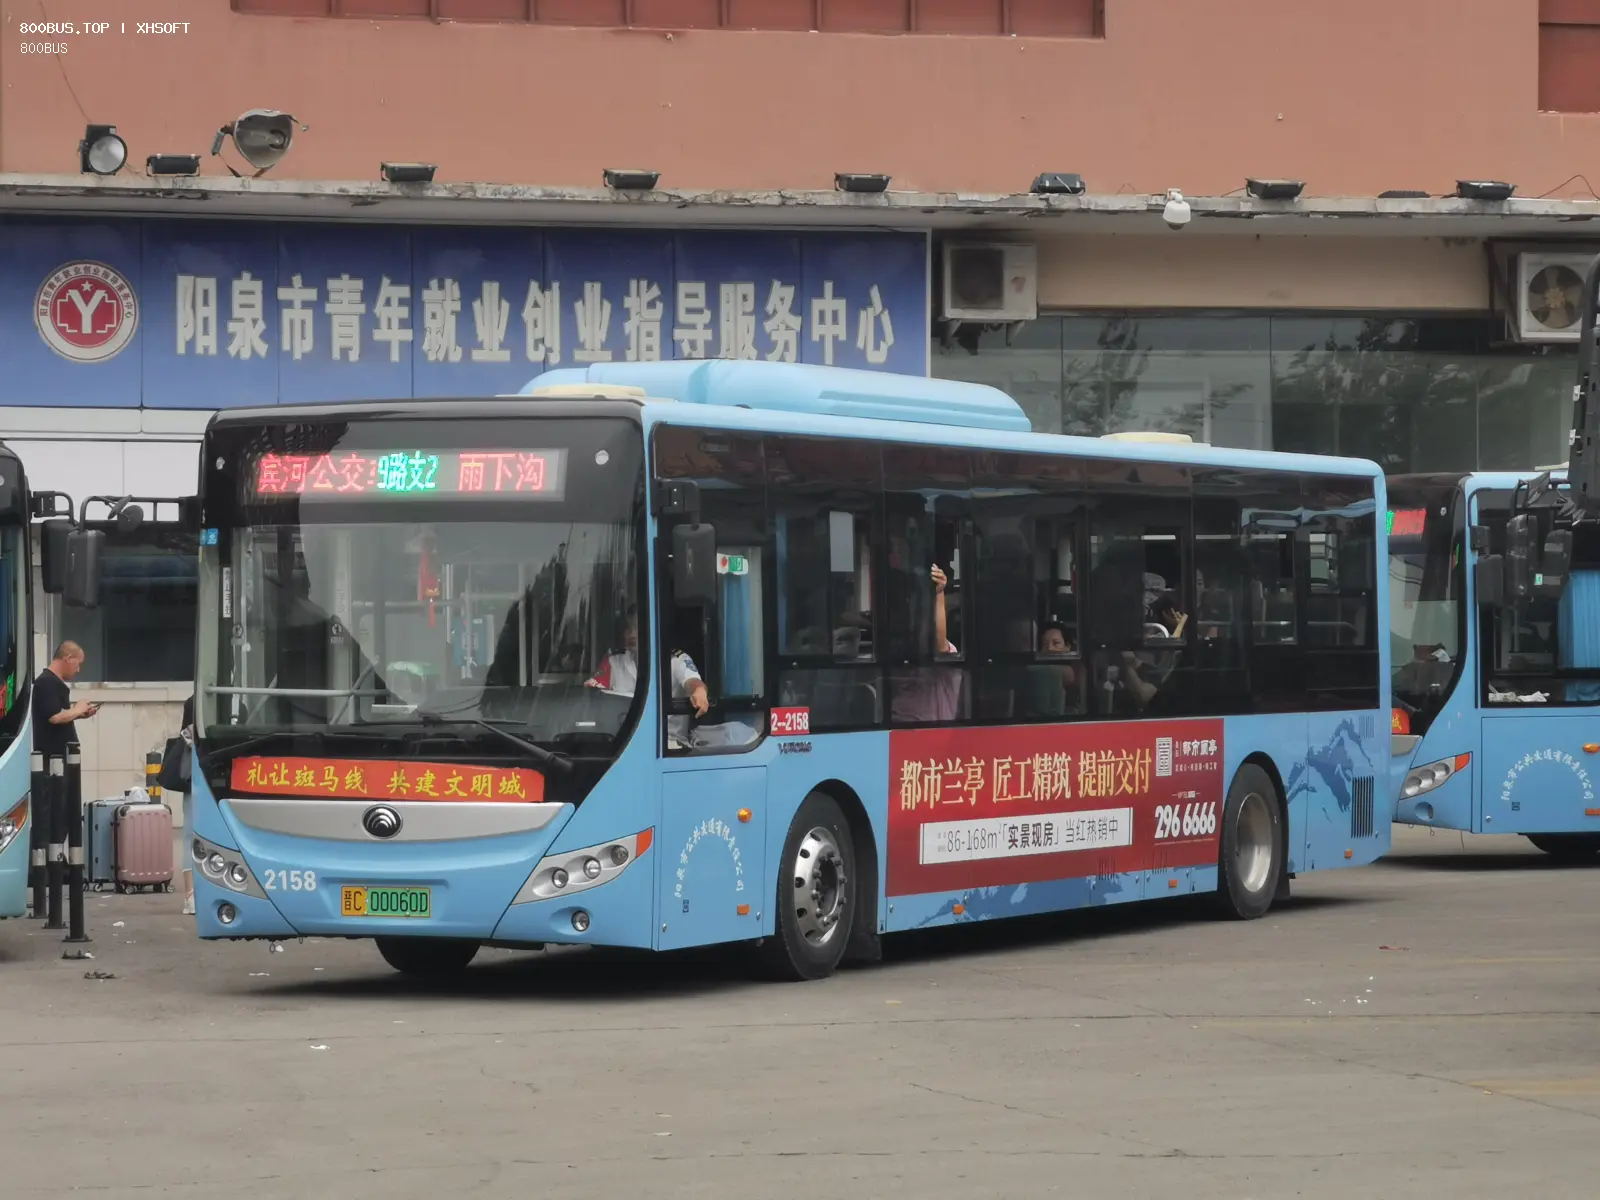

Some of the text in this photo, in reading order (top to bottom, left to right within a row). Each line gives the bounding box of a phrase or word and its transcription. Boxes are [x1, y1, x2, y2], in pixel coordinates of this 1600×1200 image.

[176, 272, 895, 363] 阳泉市青年就业创业指导服务中心
[458, 453, 546, 491] 雨下沟
[248, 761, 526, 799] 礼让斑马线 共建文明城
[899, 749, 1152, 811] 都市兰亭 匠工精筑 提前交付
[1154, 802, 1216, 839] 296 6666
[263, 869, 317, 892] 2158
